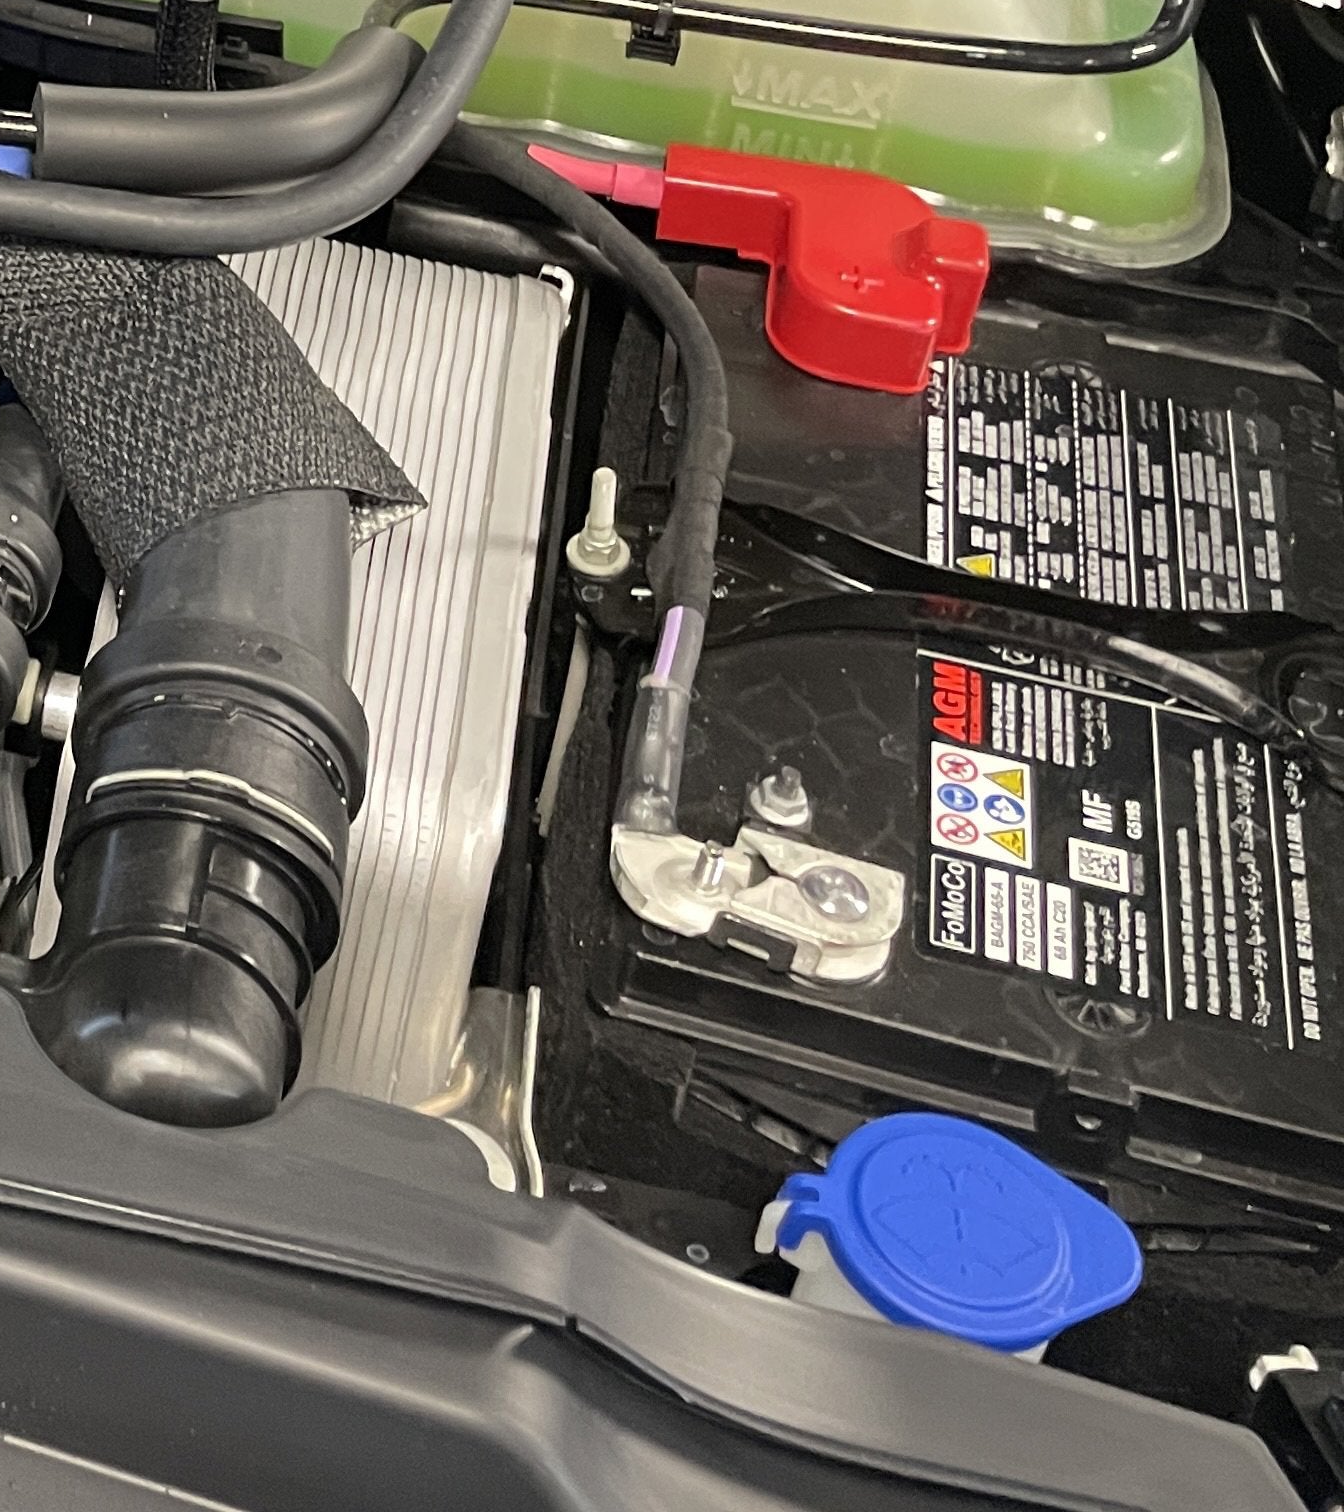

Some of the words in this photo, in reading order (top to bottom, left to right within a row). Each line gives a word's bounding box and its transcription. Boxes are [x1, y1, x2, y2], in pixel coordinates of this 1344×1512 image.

[757, 66, 882, 120] MAX
[933, 659, 967, 743] AGM
[1082, 789, 1113, 833] MF
[941, 863, 966, 947] FoMoCo
